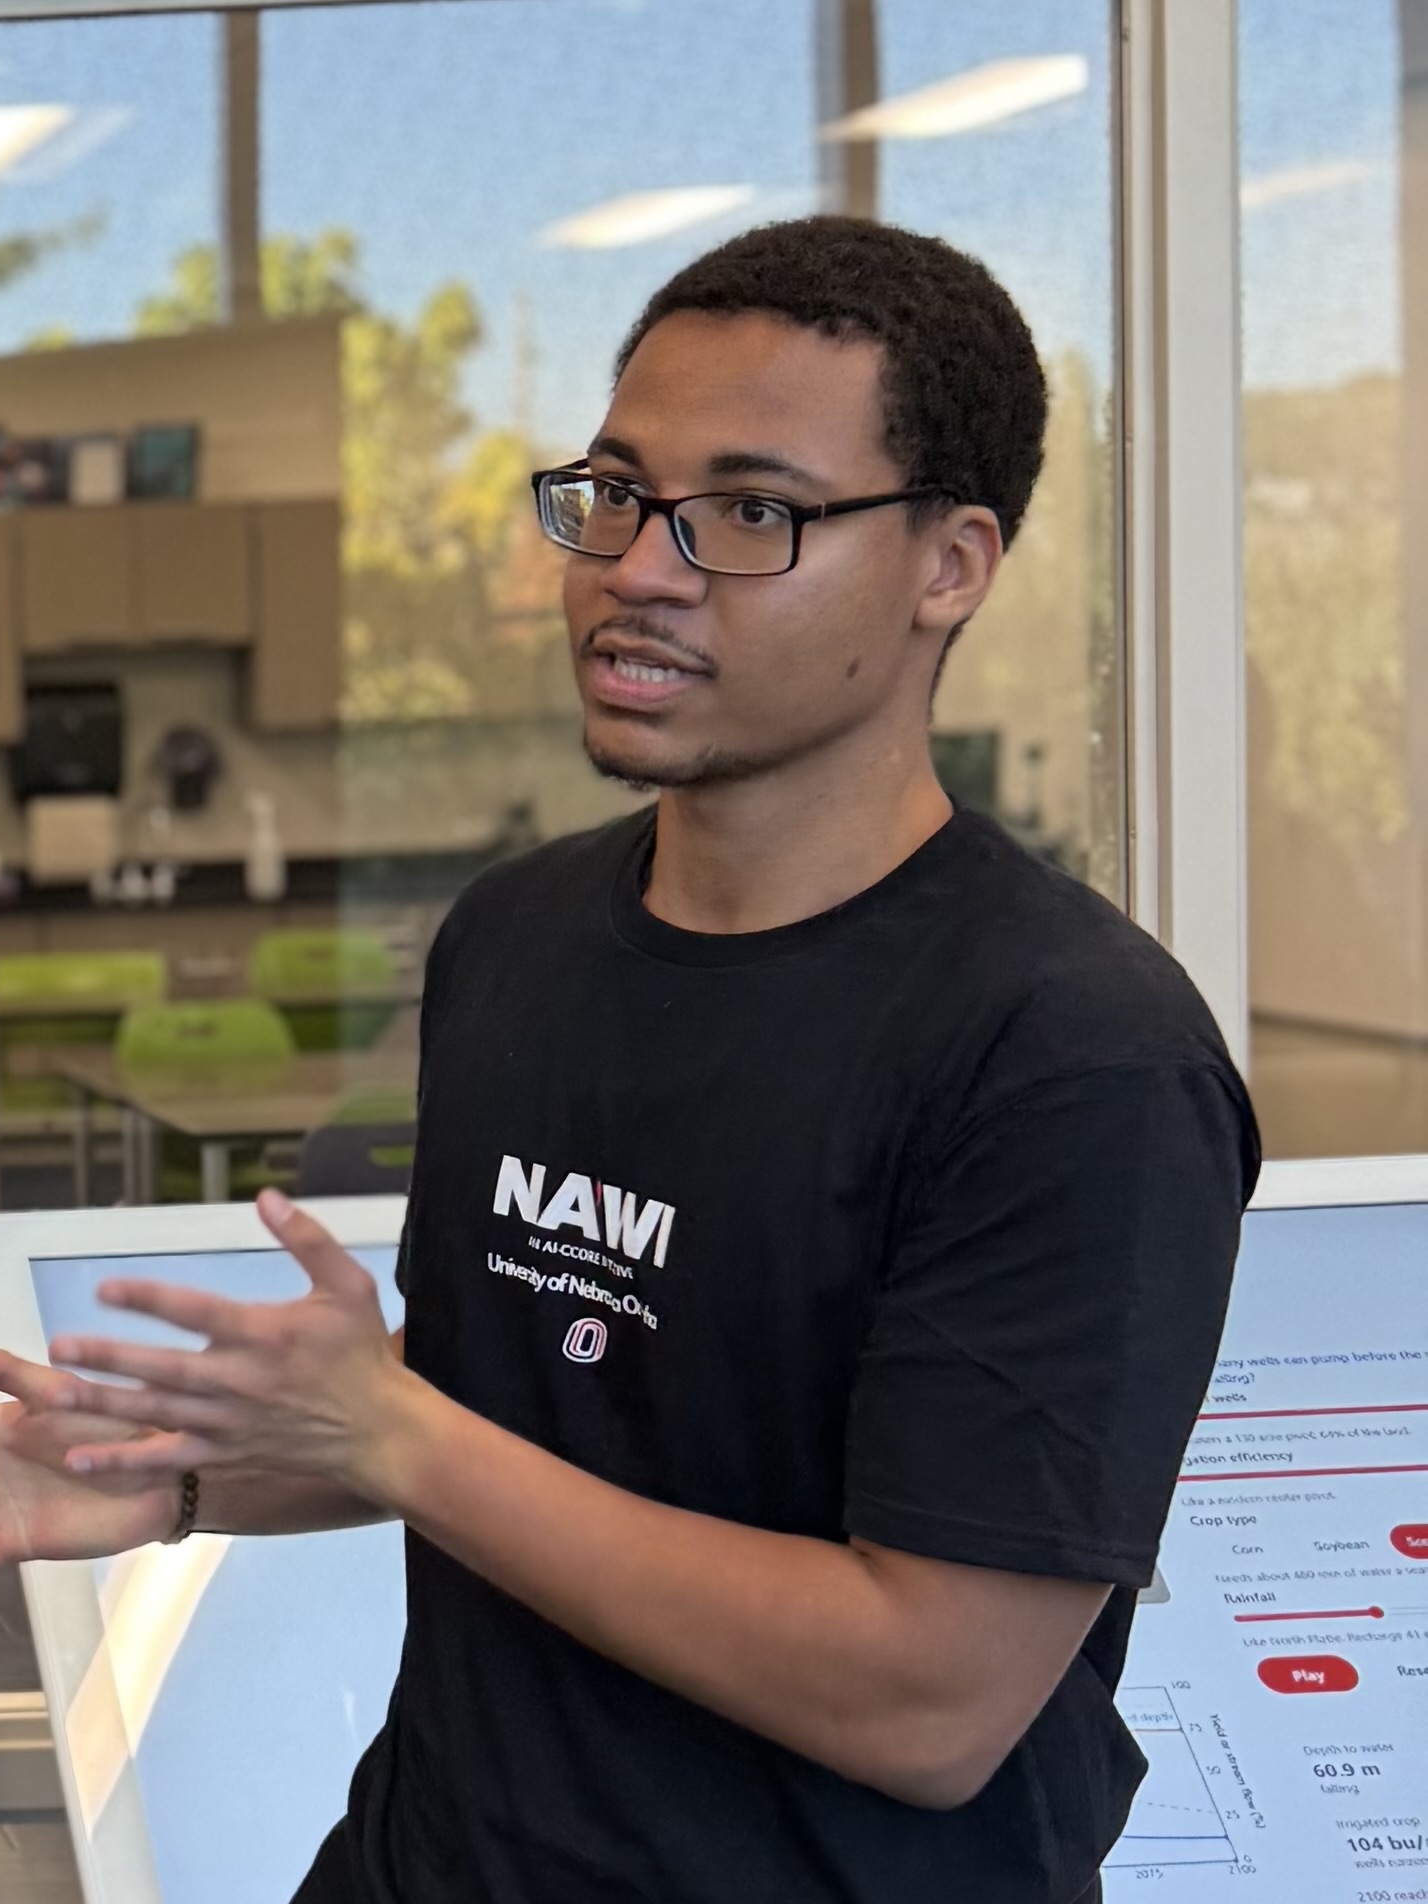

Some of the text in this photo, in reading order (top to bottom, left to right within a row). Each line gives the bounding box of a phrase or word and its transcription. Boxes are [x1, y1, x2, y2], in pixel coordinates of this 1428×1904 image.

[547, 1273, 570, 1292] of
[1230, 1452, 1293, 1463] efficiency
[1190, 1515, 1257, 1527] Crop type
[1231, 1544, 1264, 1555] Corn
[1292, 1669, 1325, 1684] Play
[1313, 1763, 1381, 1778] 60.9 m
[1347, 1837, 1384, 1852] 104
[1357, 1890, 1391, 1903] 2100
